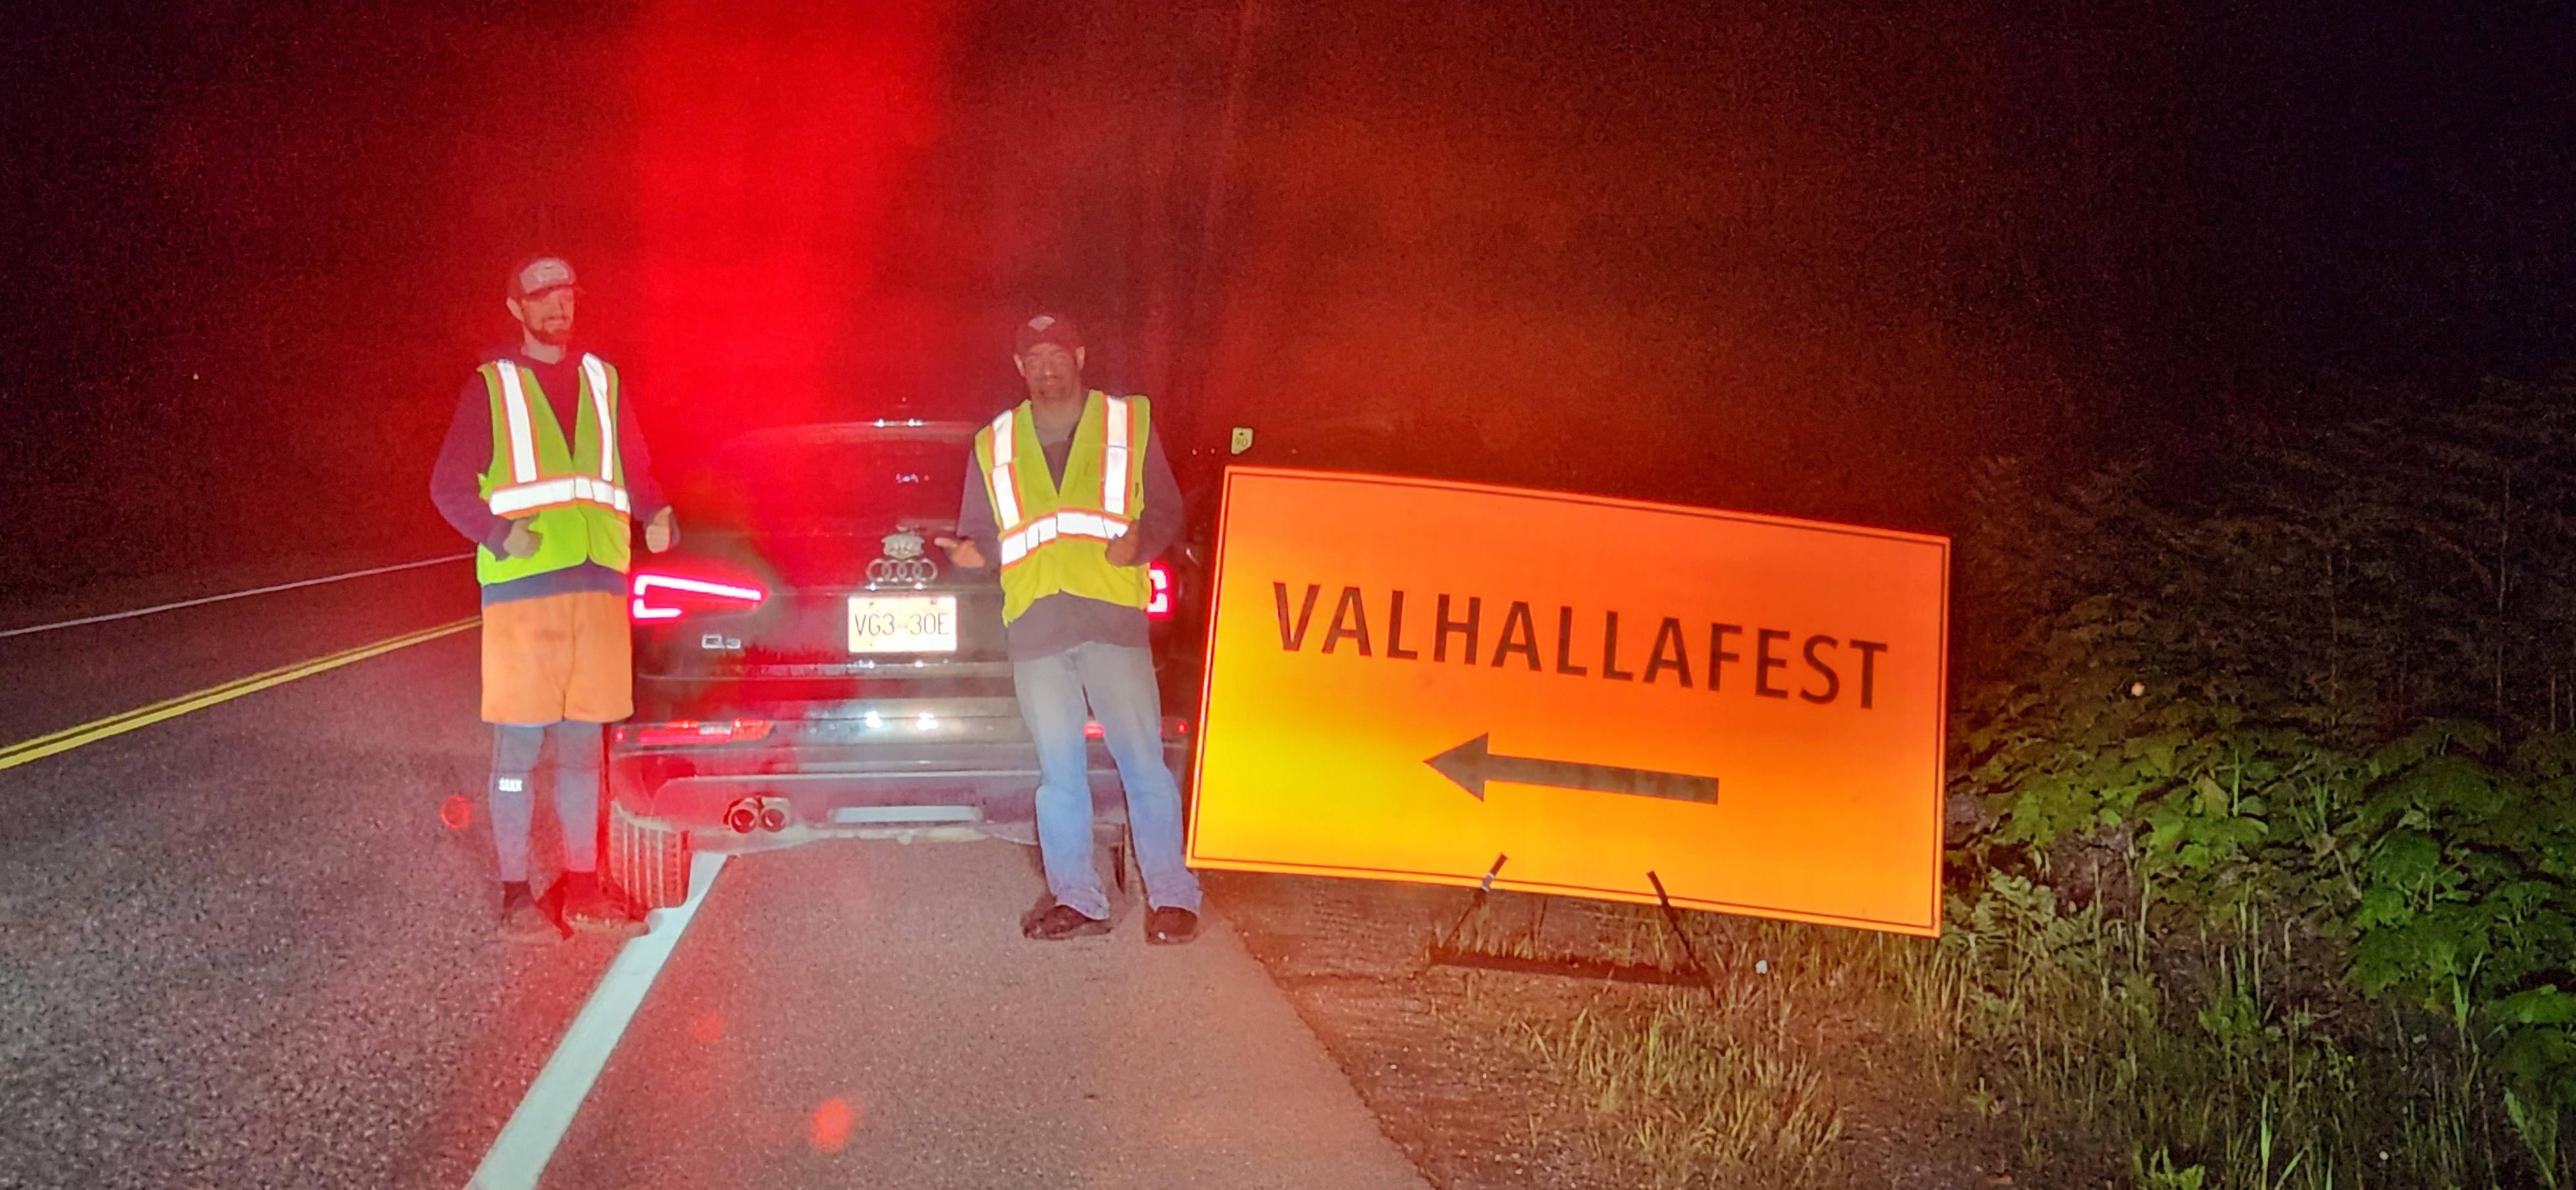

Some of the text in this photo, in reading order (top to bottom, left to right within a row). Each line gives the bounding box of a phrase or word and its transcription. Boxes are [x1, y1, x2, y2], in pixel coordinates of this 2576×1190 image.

[855, 612, 950, 636] VG3 30E
[1273, 582, 1888, 709] VALHALLAFEST
